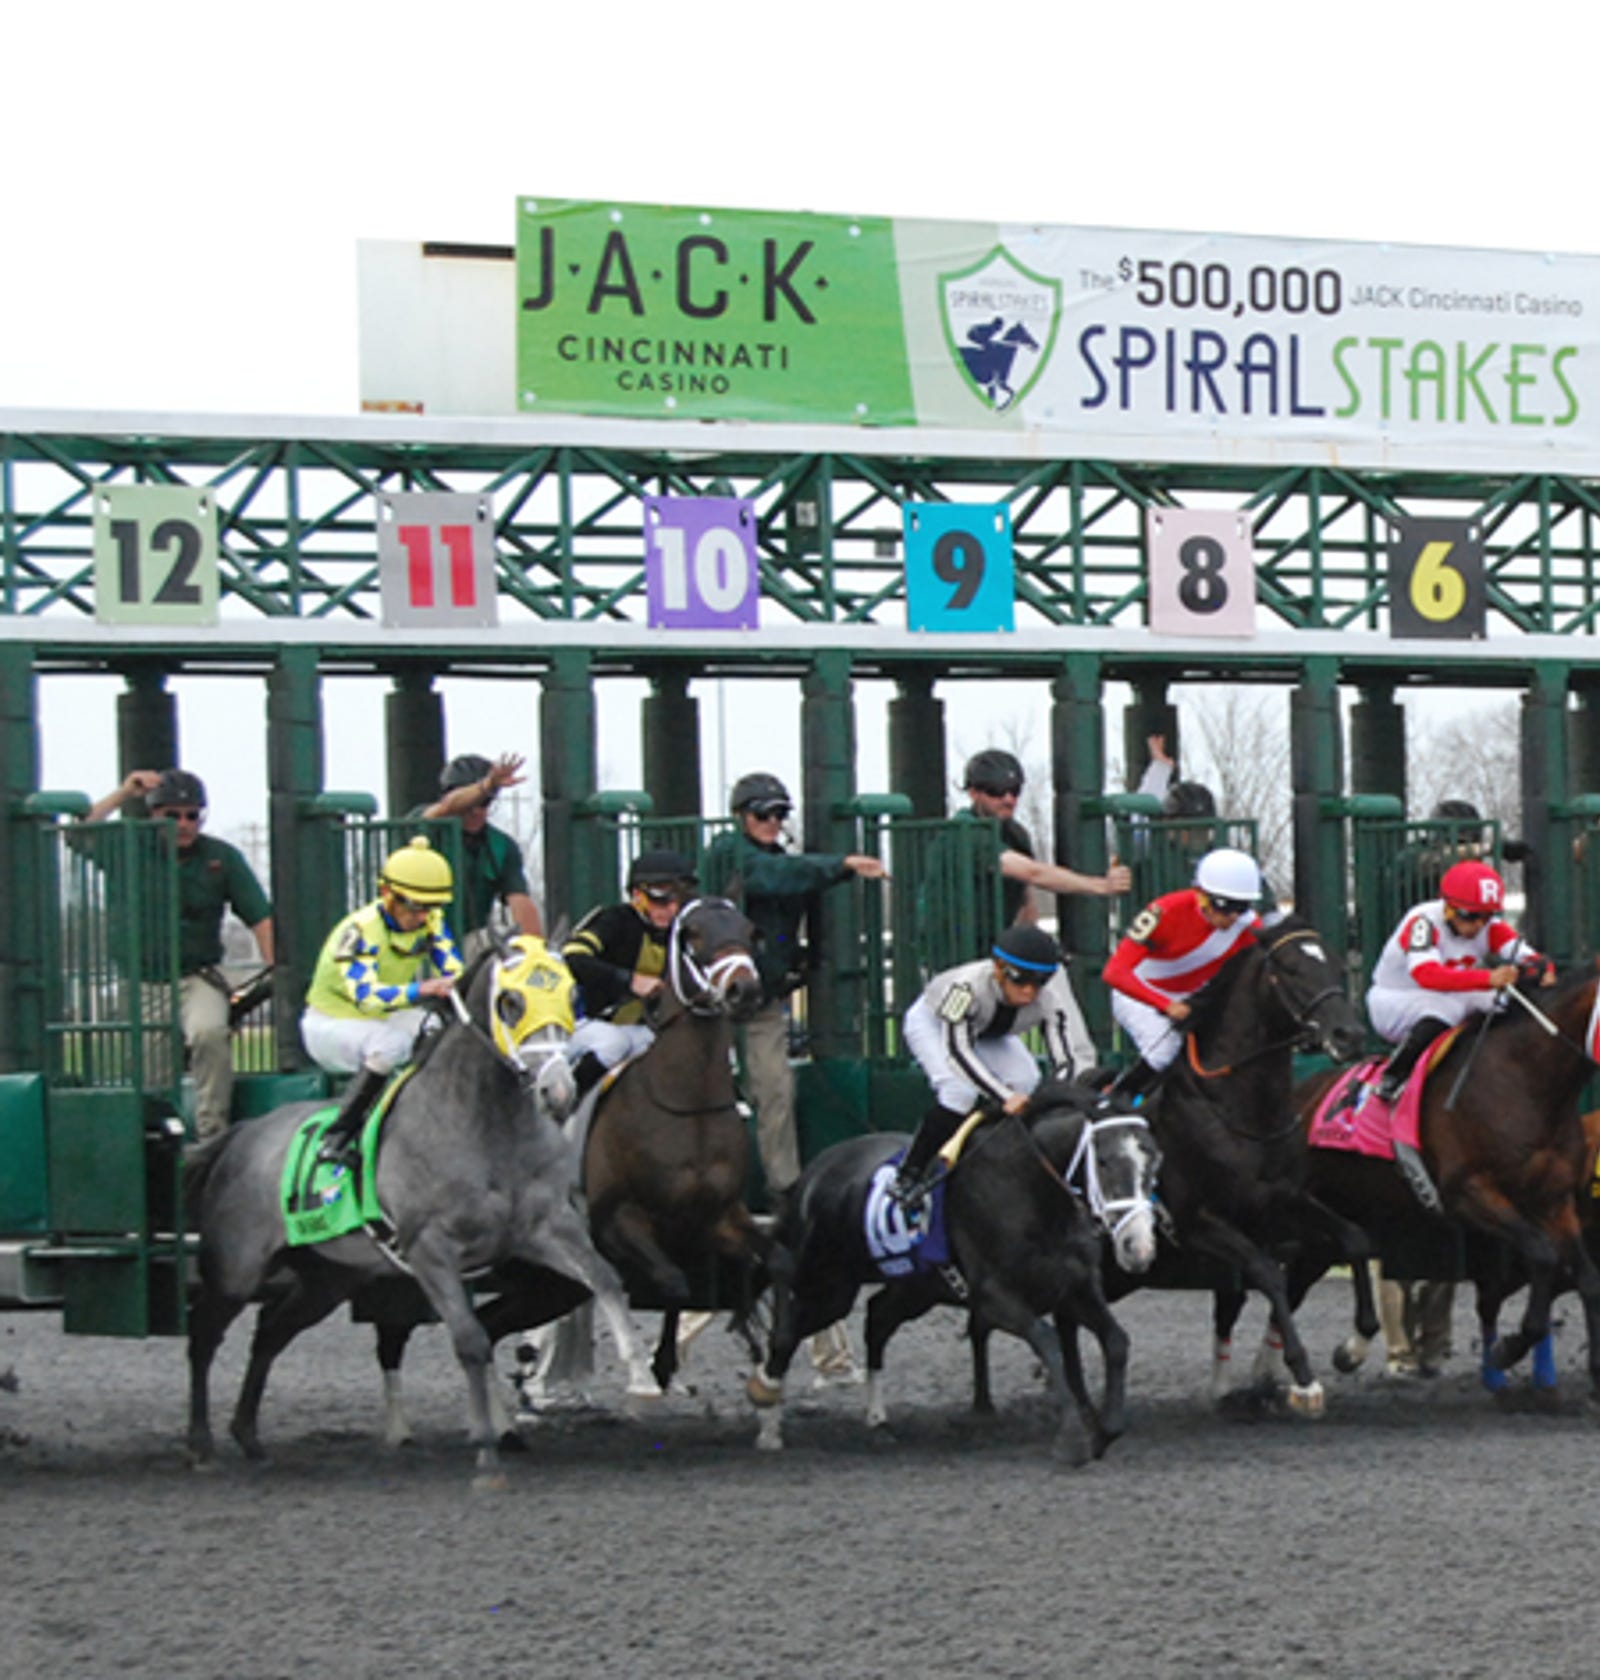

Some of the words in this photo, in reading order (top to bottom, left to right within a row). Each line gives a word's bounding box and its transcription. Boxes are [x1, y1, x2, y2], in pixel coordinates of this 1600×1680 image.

[1080, 270, 1115, 292] The
[1350, 286, 1406, 308] JACK
[1408, 287, 1512, 314] Cincinnati
[1515, 293, 1584, 318] Casino
[557, 334, 790, 372] CINCINNATI
[616, 370, 731, 395] CASINO
[109, 519, 202, 604] 12
[398, 525, 477, 608] 11
[654, 527, 749, 613] 10
[932, 530, 986, 610] 9
[1177, 536, 1229, 613] 8
[1409, 541, 1467, 623] 6
[1479, 879, 1499, 903] R
[1127, 908, 1160, 943] 9
[1411, 920, 1431, 948] 8
